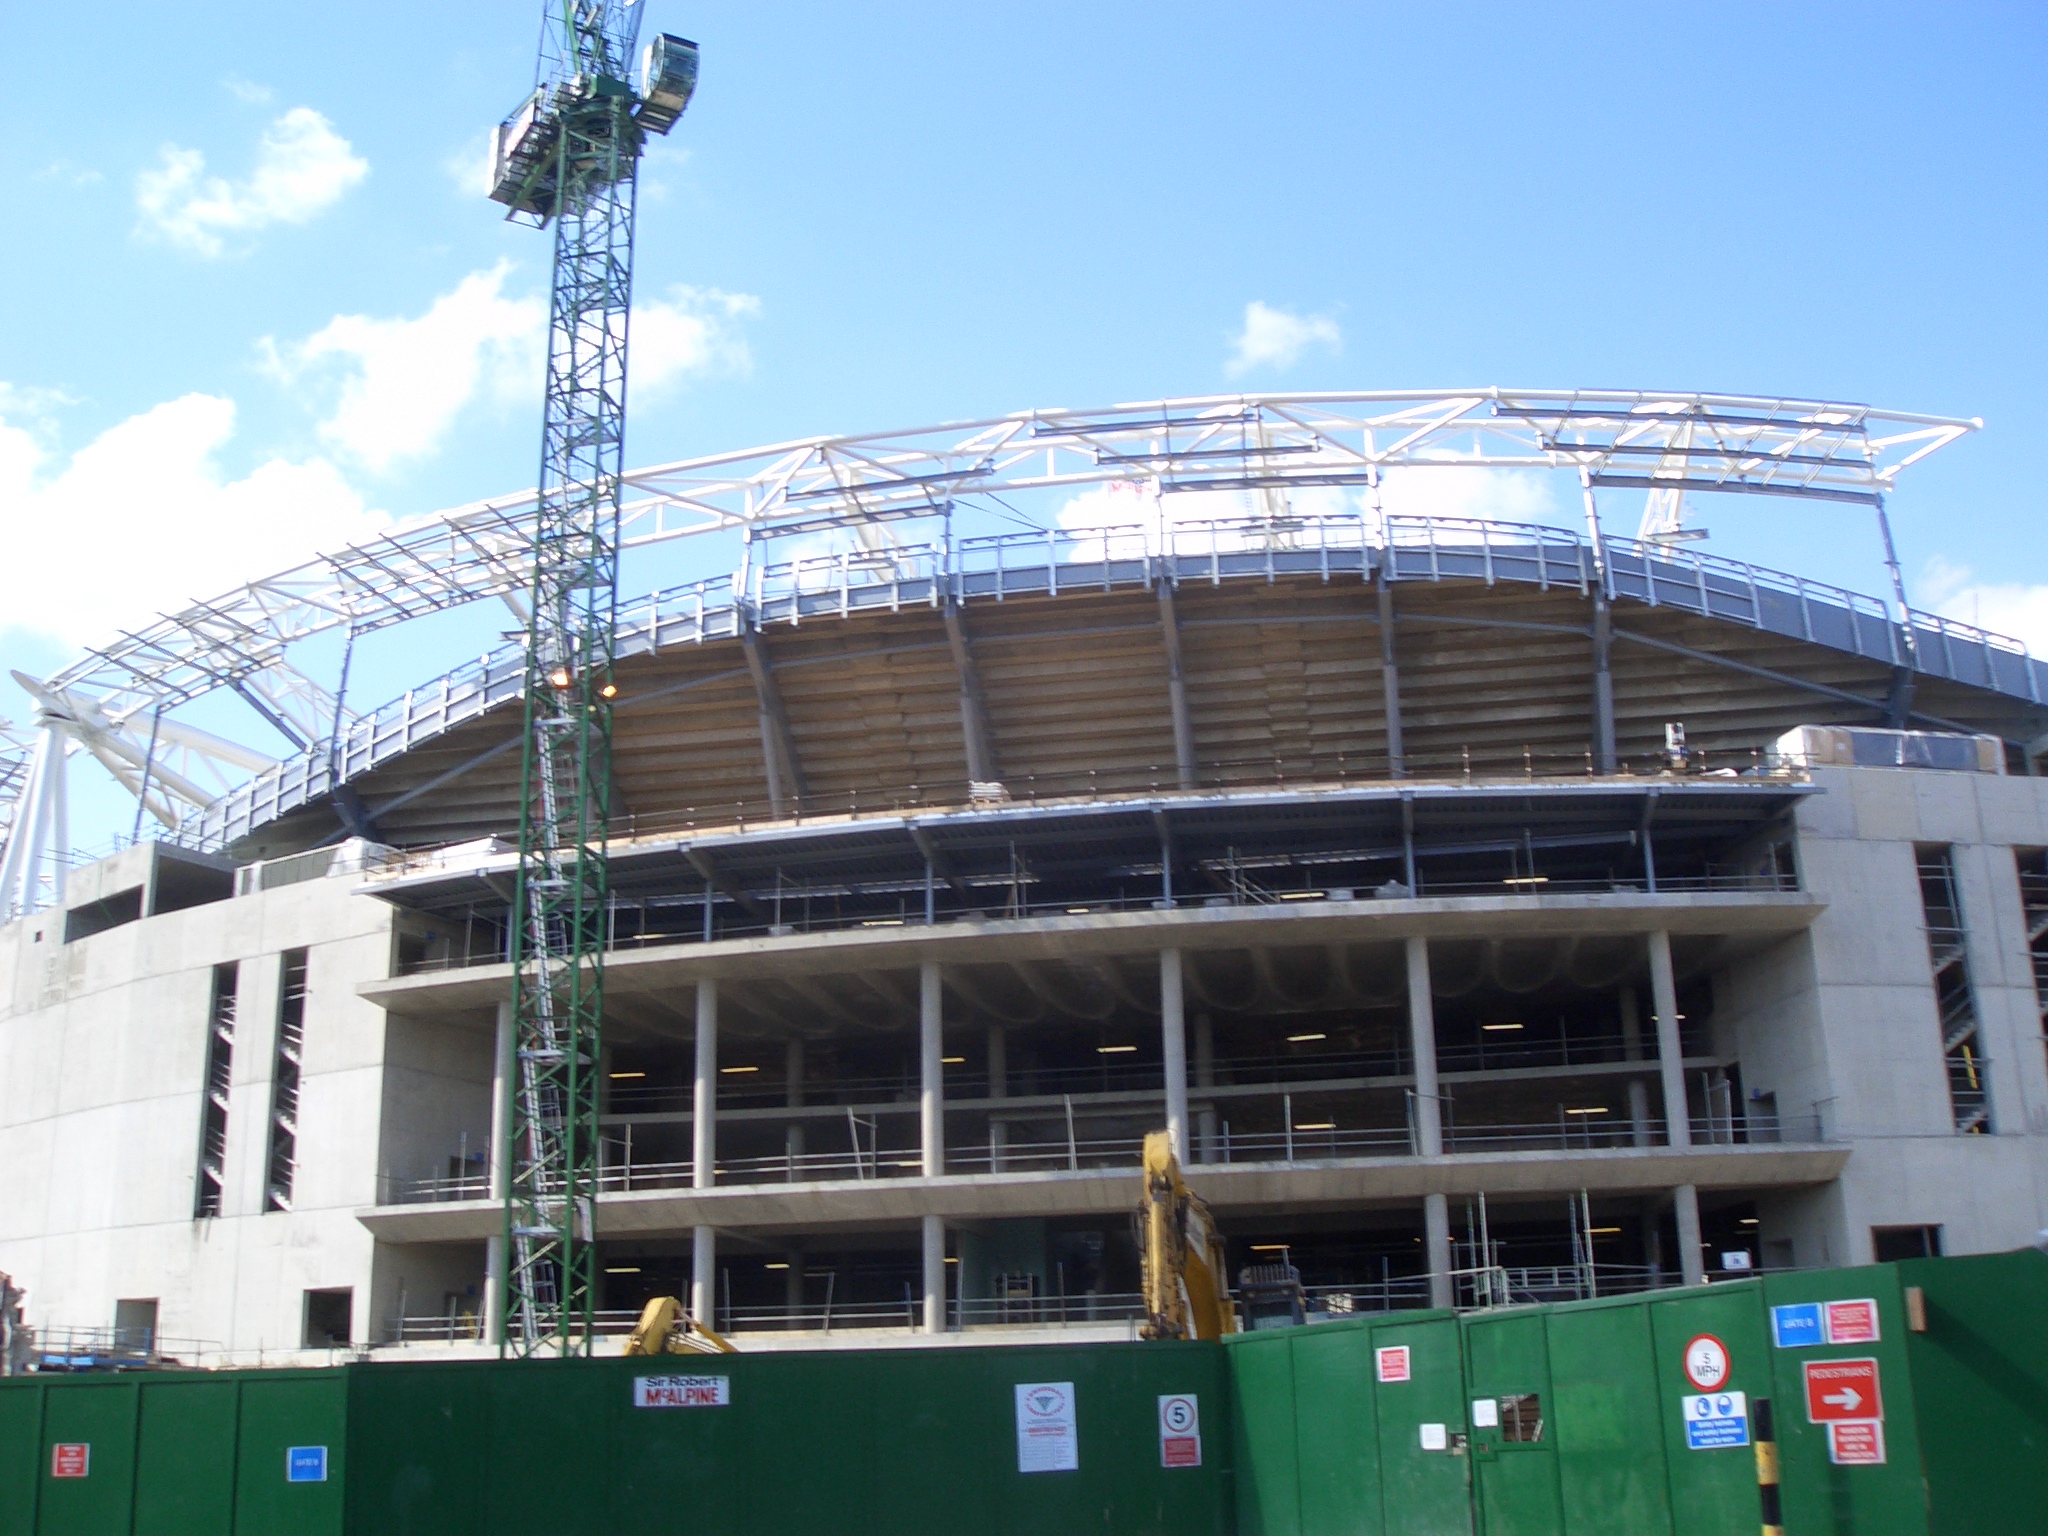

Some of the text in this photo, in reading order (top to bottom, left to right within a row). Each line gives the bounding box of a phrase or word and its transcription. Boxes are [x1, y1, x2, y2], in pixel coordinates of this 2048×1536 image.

[1703, 1352, 1711, 1365] 5
[1694, 1364, 1720, 1377] MPH
[1808, 1366, 1873, 1379] PEDESTRIANS
[646, 1376, 718, 1387] Sir Robert
[1173, 1406, 1185, 1424] 5
